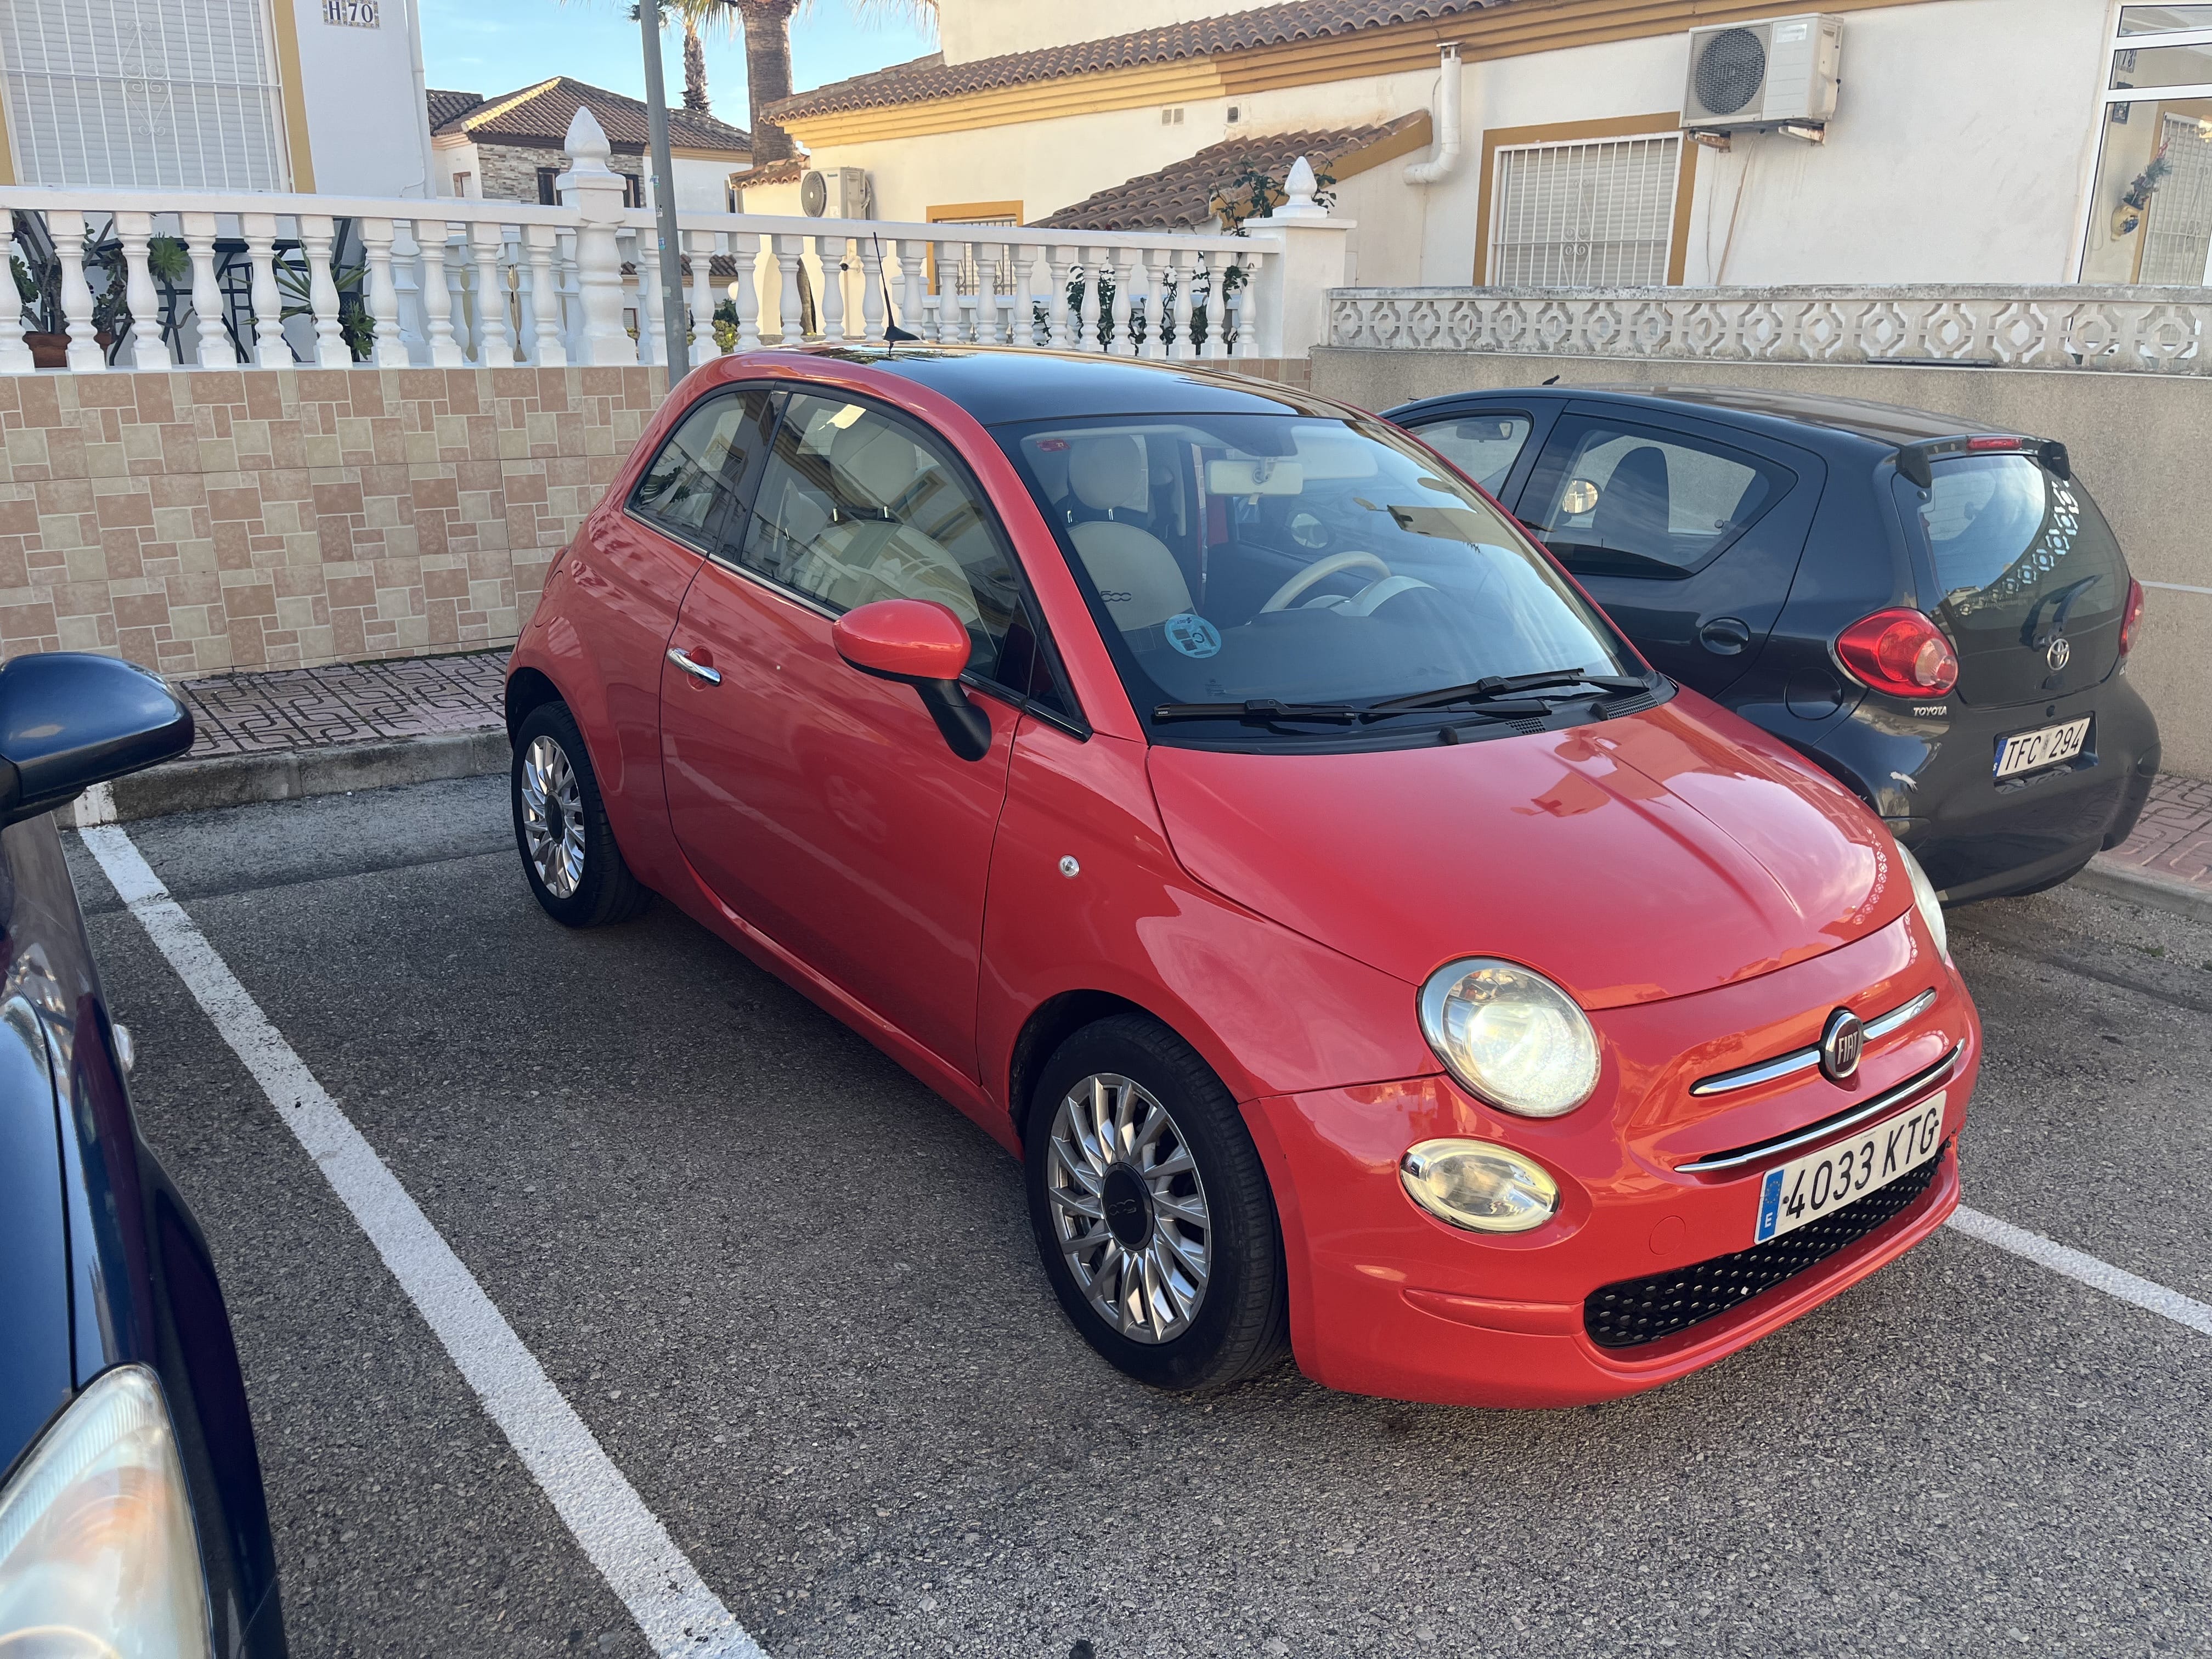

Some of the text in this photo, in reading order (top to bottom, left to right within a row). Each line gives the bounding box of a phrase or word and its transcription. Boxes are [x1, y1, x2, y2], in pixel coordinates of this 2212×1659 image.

[329, 1, 373, 22] H 70
[1913, 706, 1948, 716] TOYOTA
[2005, 723, 2084, 770] TFC 294
[1837, 1031, 1858, 1064] FIAT
[1787, 1107, 1939, 1219] 4033 KTG
[1764, 1212, 1773, 1228] E
